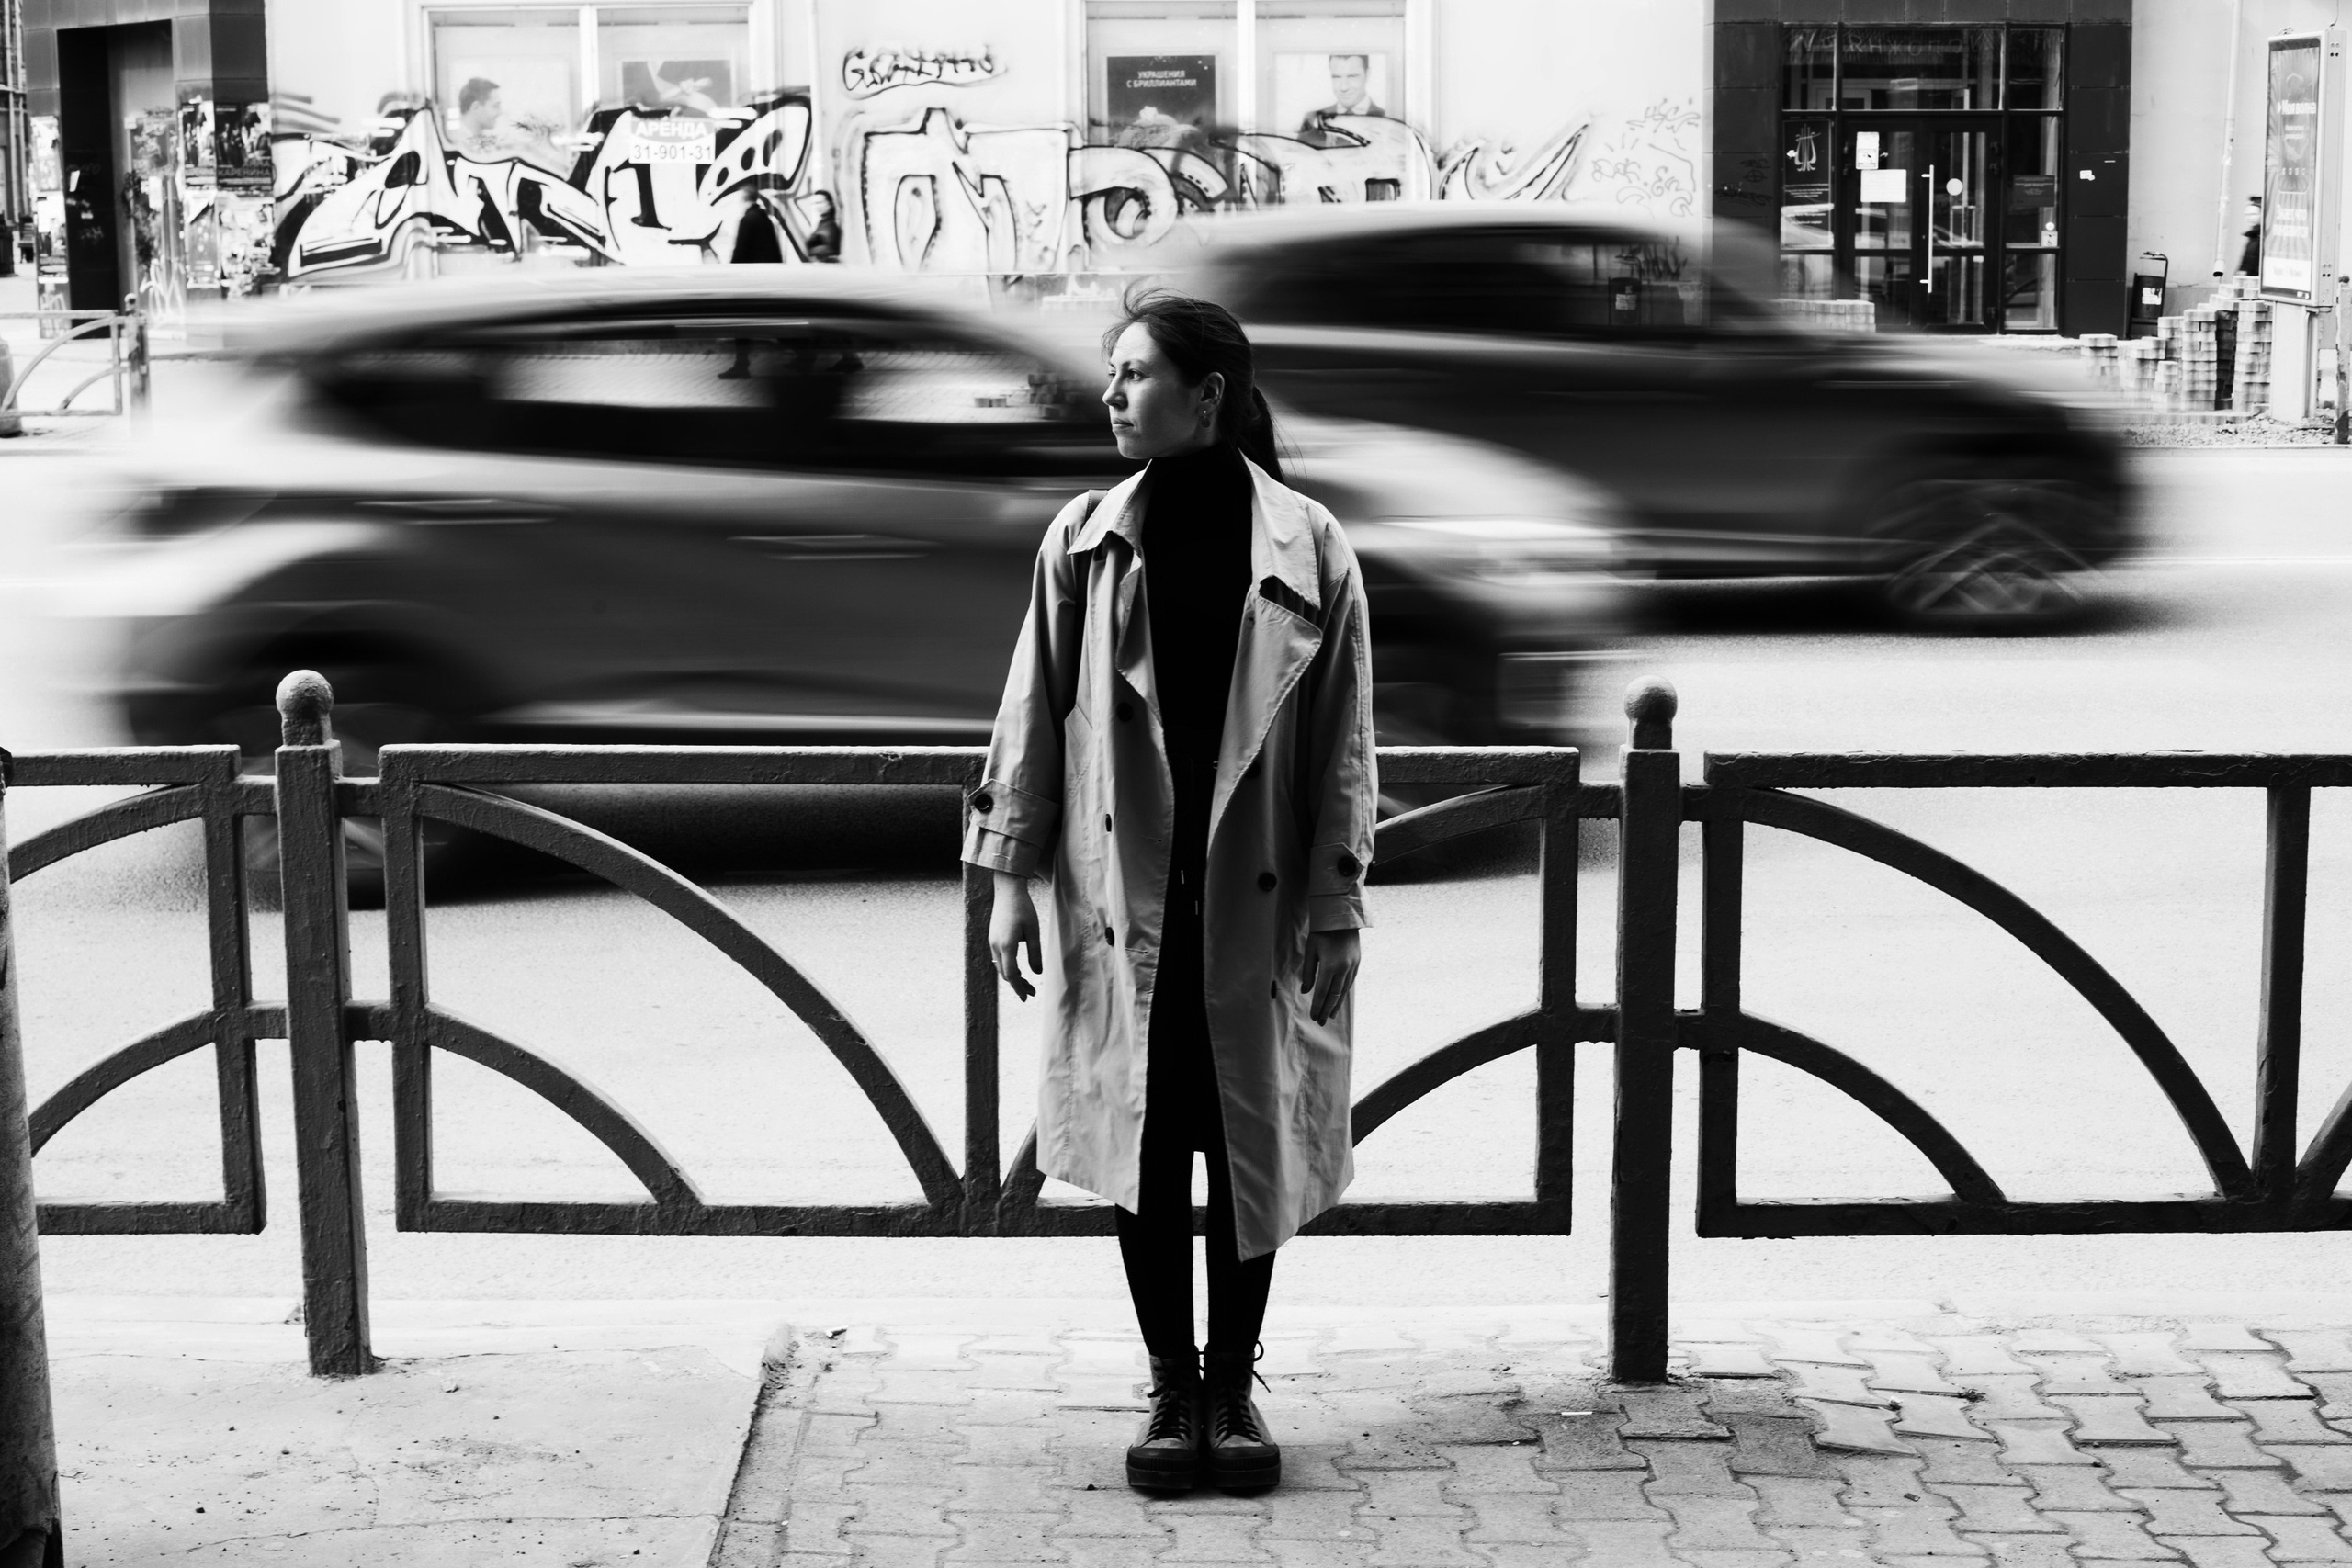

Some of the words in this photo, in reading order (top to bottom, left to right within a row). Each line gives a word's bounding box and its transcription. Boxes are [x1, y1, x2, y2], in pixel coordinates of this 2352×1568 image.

[1137, 70, 1185, 79] УКРАШЕНИЯ
[1126, 80, 1132, 88] С
[1133, 79, 1197, 88] БРИЛЛИАНТАМИ
[635, 121, 708, 140] АРЕНДА
[634, 145, 711, 160] 31-901-31
